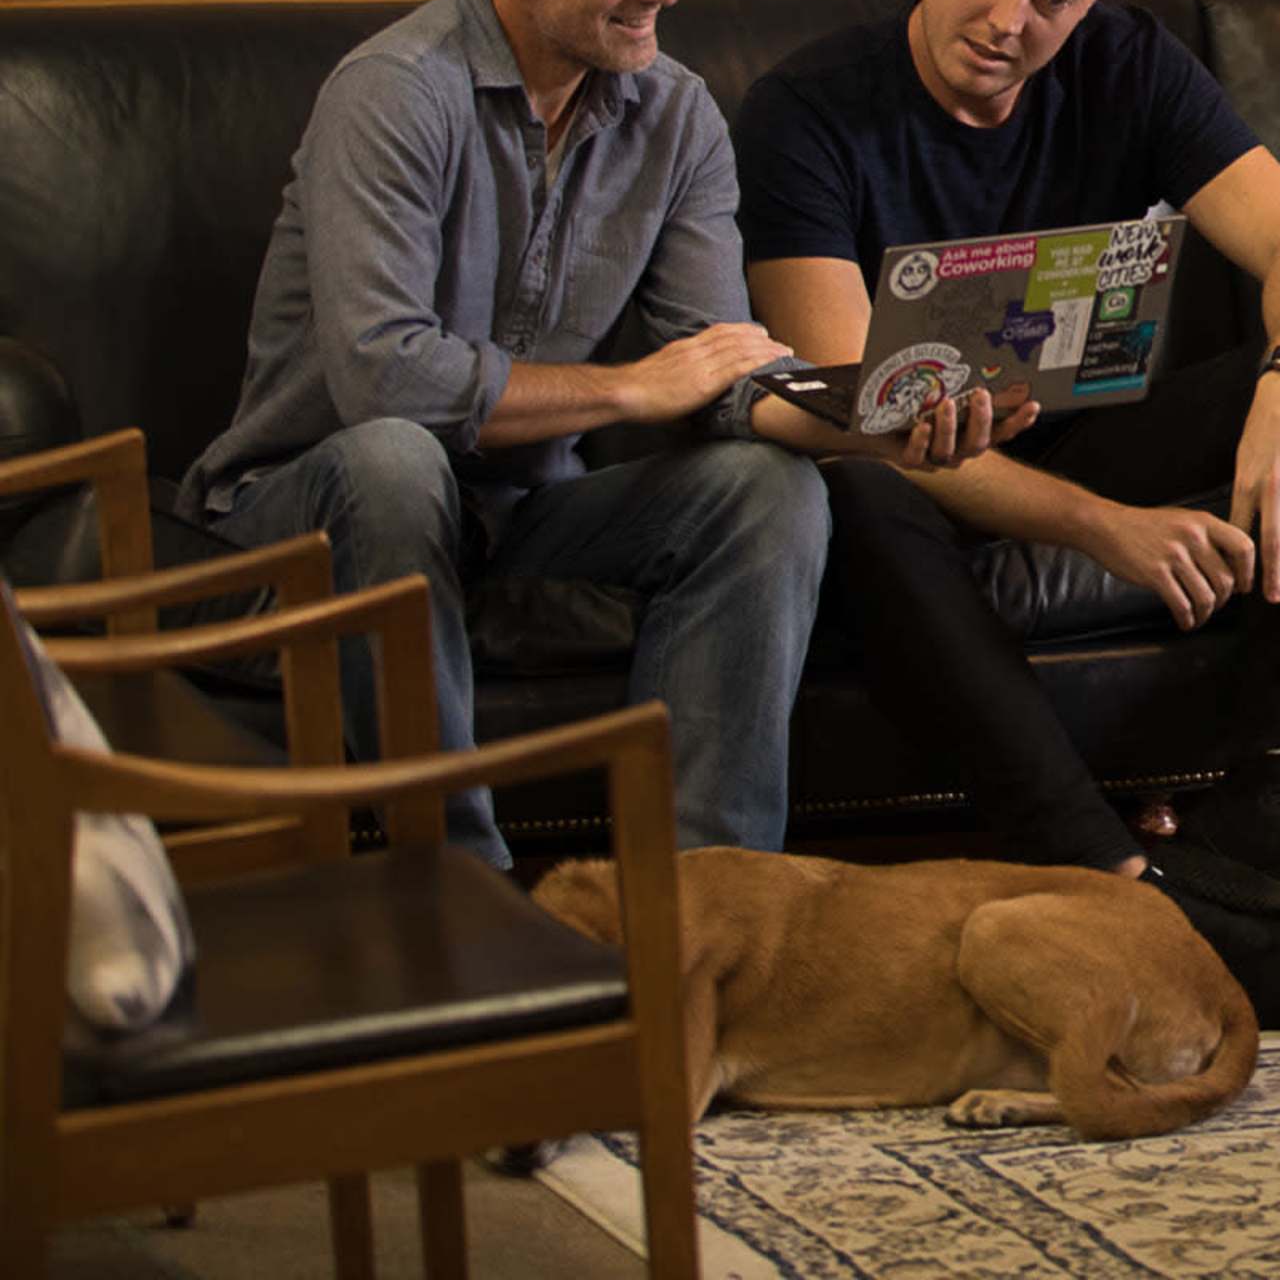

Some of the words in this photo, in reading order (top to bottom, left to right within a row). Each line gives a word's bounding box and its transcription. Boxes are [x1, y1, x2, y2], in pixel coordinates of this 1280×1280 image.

[1111, 222, 1158, 248] NEW
[942, 249, 968, 262] Ask
[971, 246, 993, 258] me
[995, 239, 1036, 255] about
[939, 253, 1036, 277] Coworking
[1098, 261, 1152, 289] CITIES
